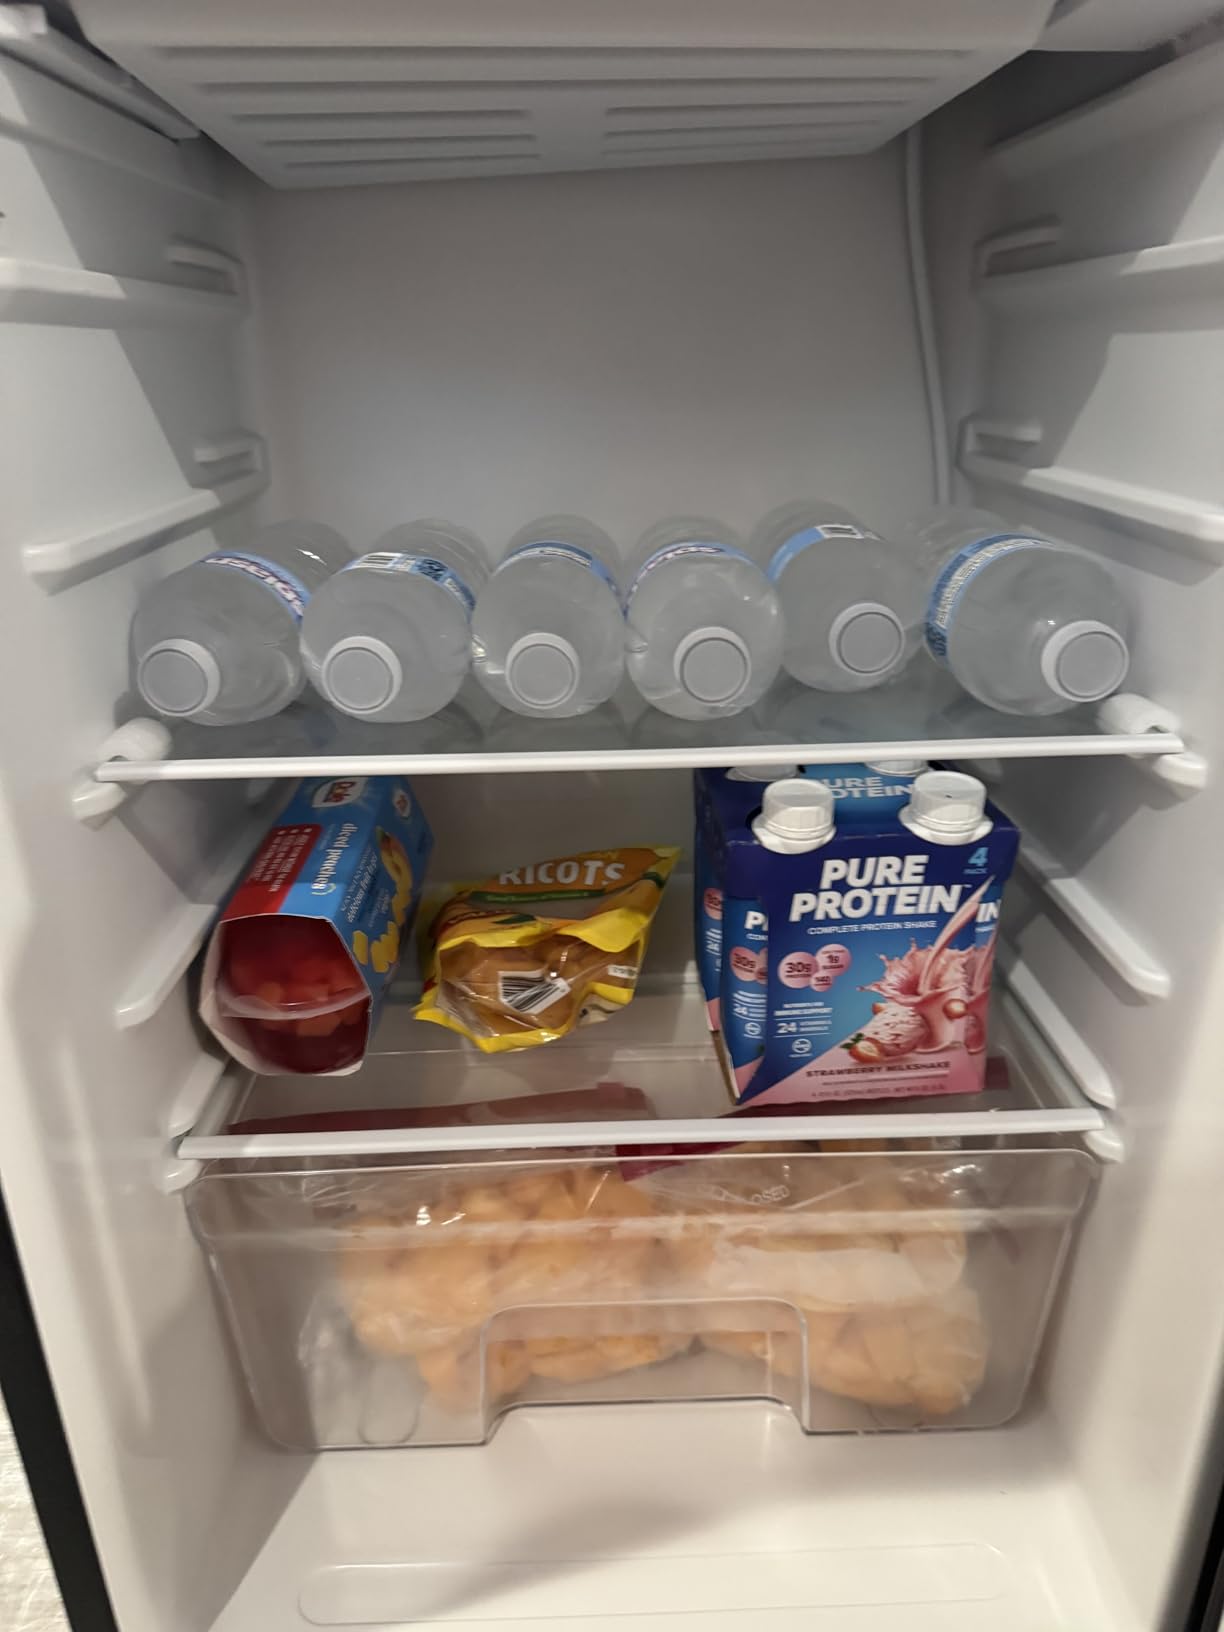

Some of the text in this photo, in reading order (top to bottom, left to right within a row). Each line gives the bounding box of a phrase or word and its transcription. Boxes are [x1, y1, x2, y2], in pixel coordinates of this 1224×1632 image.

[332, 823, 358, 848] diced
[967, 847, 988, 867] 4
[311, 849, 343, 889] peaches
[819, 854, 929, 889] PURE
[789, 884, 963, 922] PROTEIN
[807, 920, 937, 935] COMPLETE PROTEIN SHAKE
[777, 1022, 798, 1034] 24
[806, 1061, 950, 1077] STRAWBERRY MILKSHAKE
